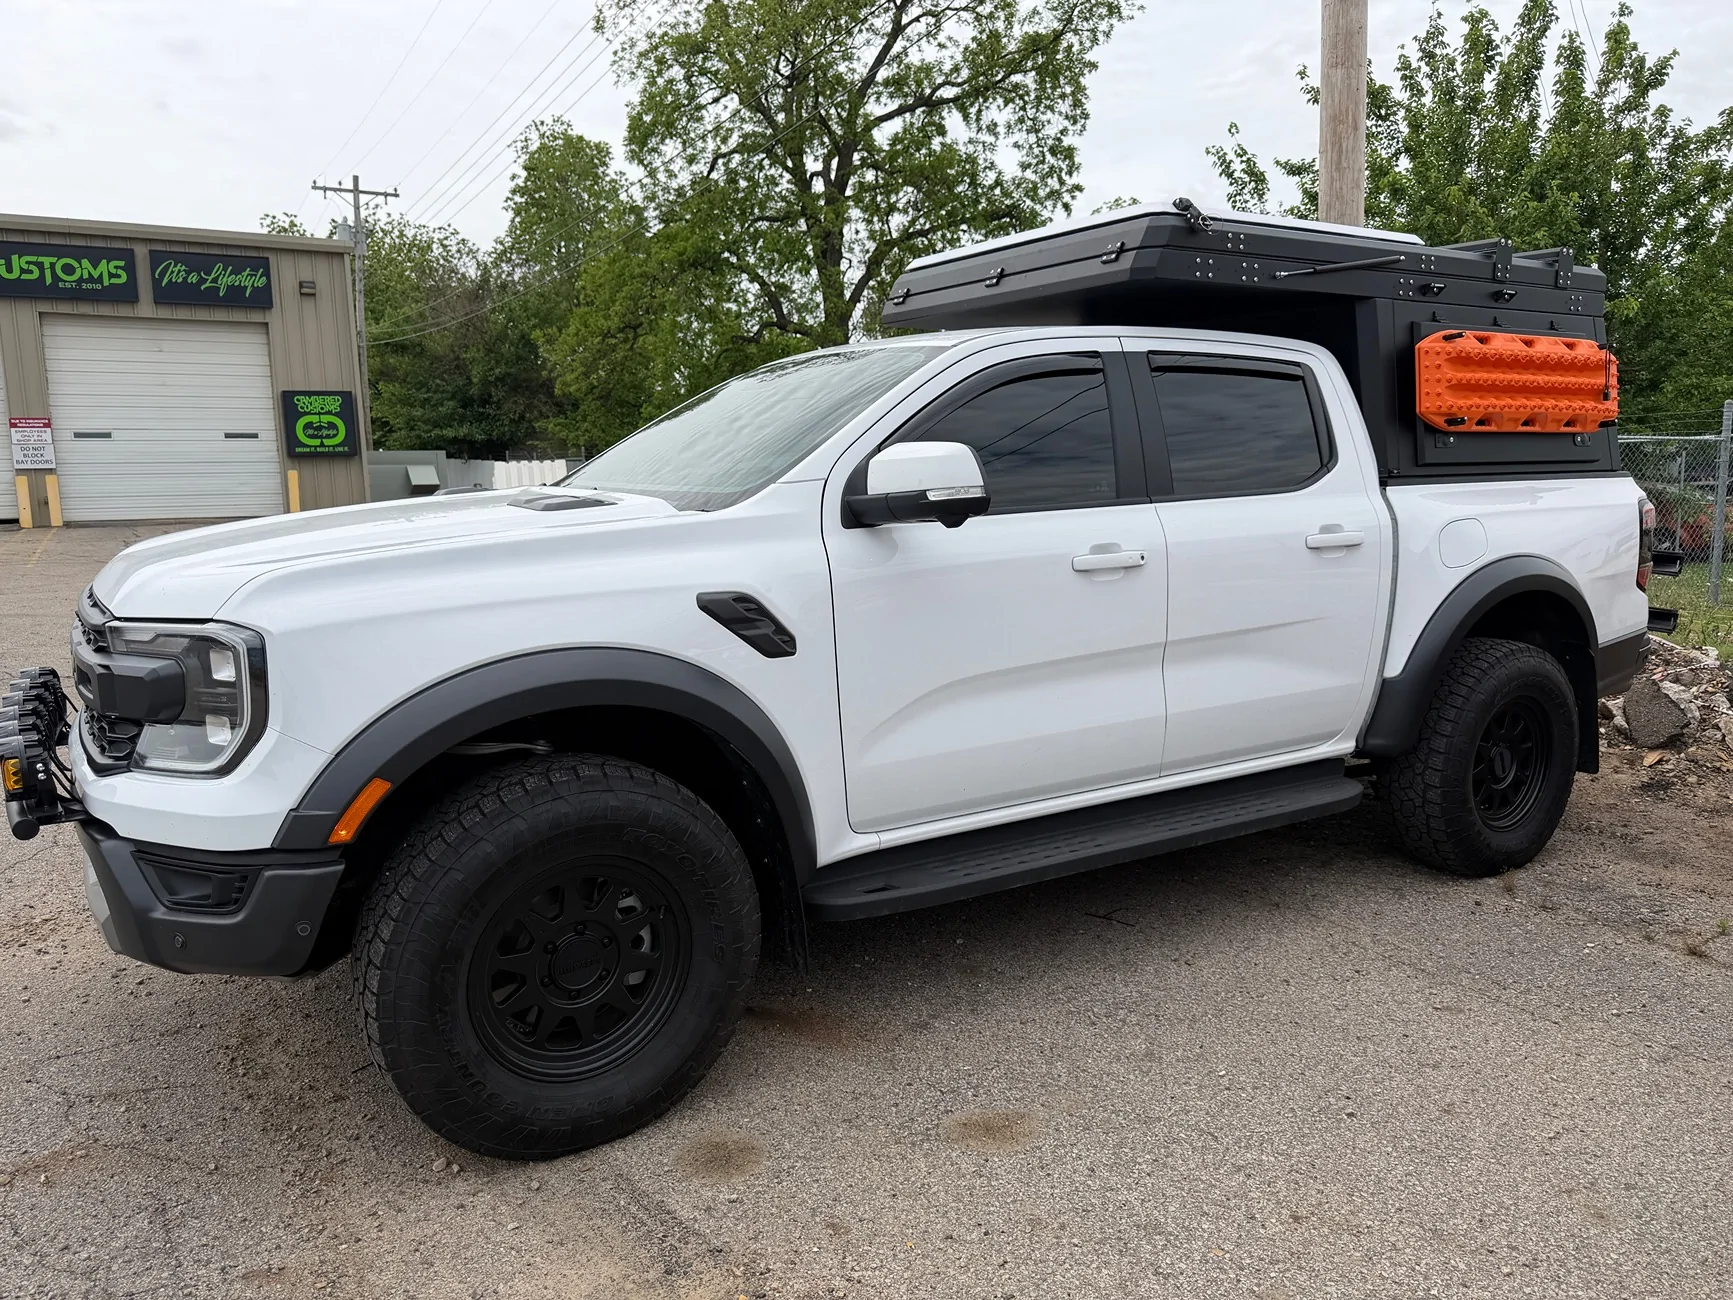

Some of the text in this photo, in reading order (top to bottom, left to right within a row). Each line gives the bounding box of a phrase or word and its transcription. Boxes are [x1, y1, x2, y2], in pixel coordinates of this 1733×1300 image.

[187, 272, 200, 284] a
[200, 262, 268, 298] Lifestyle
[58, 281, 102, 290] EST. 2010
[293, 395, 342, 405] CAMBERED
[297, 403, 341, 413] CUSTOMS
[622, 827, 698, 871] TOYO
